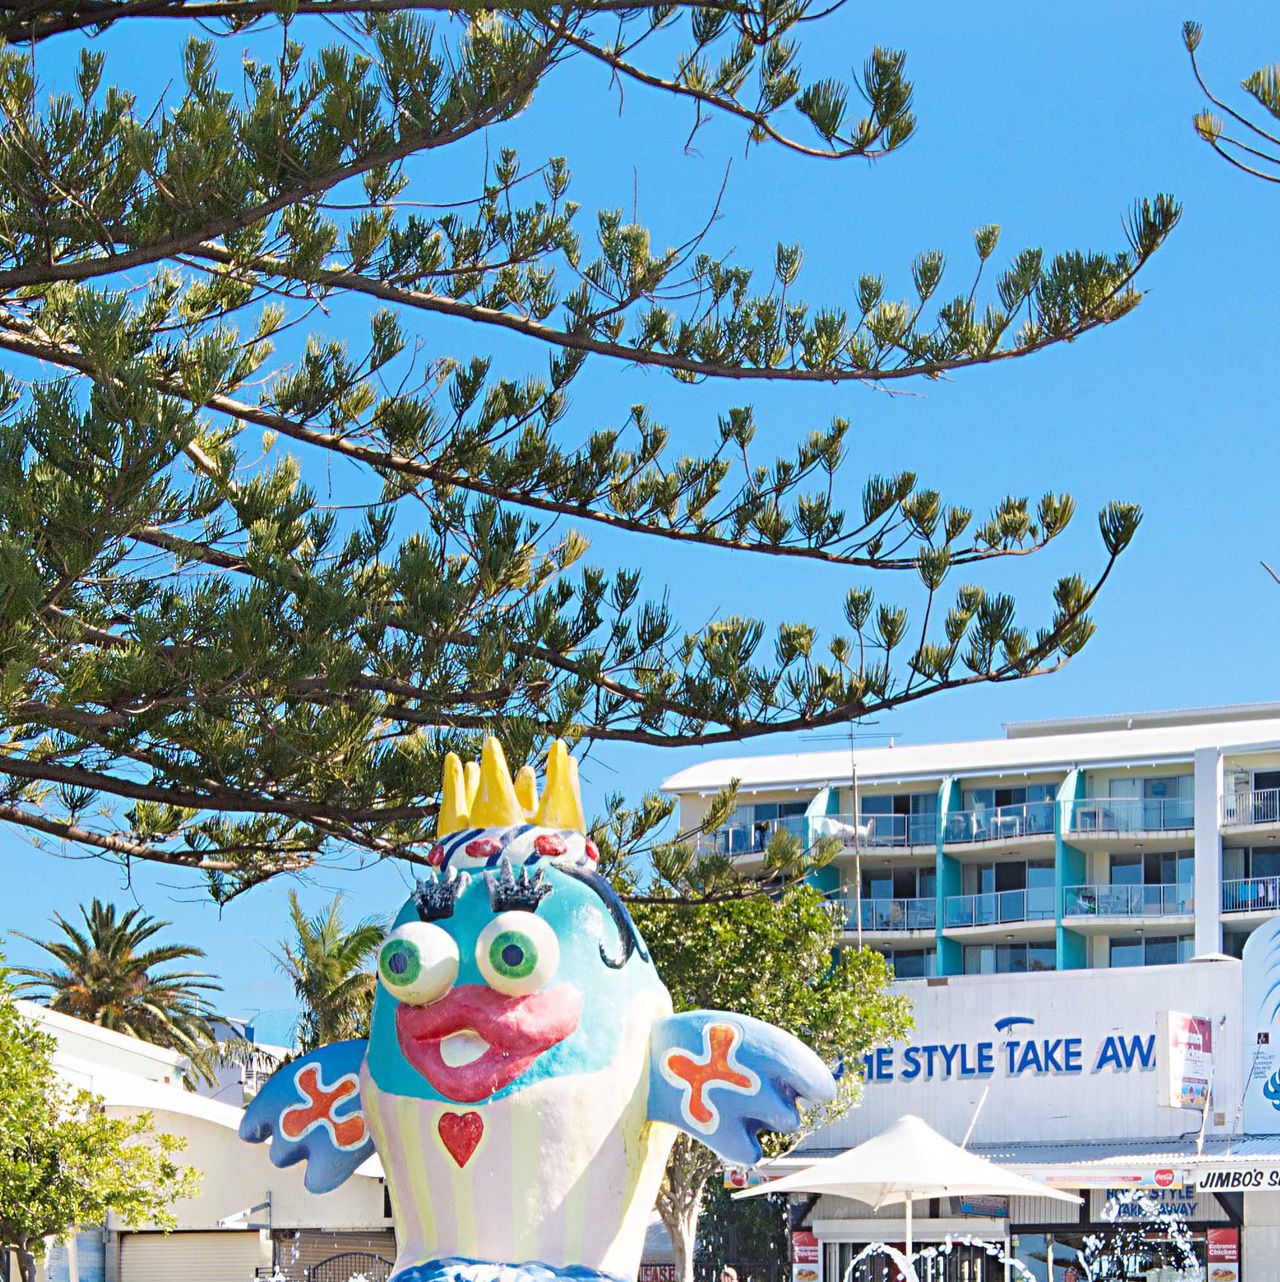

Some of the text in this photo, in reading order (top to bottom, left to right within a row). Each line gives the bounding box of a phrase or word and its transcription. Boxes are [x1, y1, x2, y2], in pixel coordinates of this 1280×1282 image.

[901, 1042, 995, 1078] STYLE
[1005, 1037, 1083, 1074] TAKE
[1096, 1034, 1156, 1070] AW
[1200, 1168, 1264, 1189] JIMBO'S
